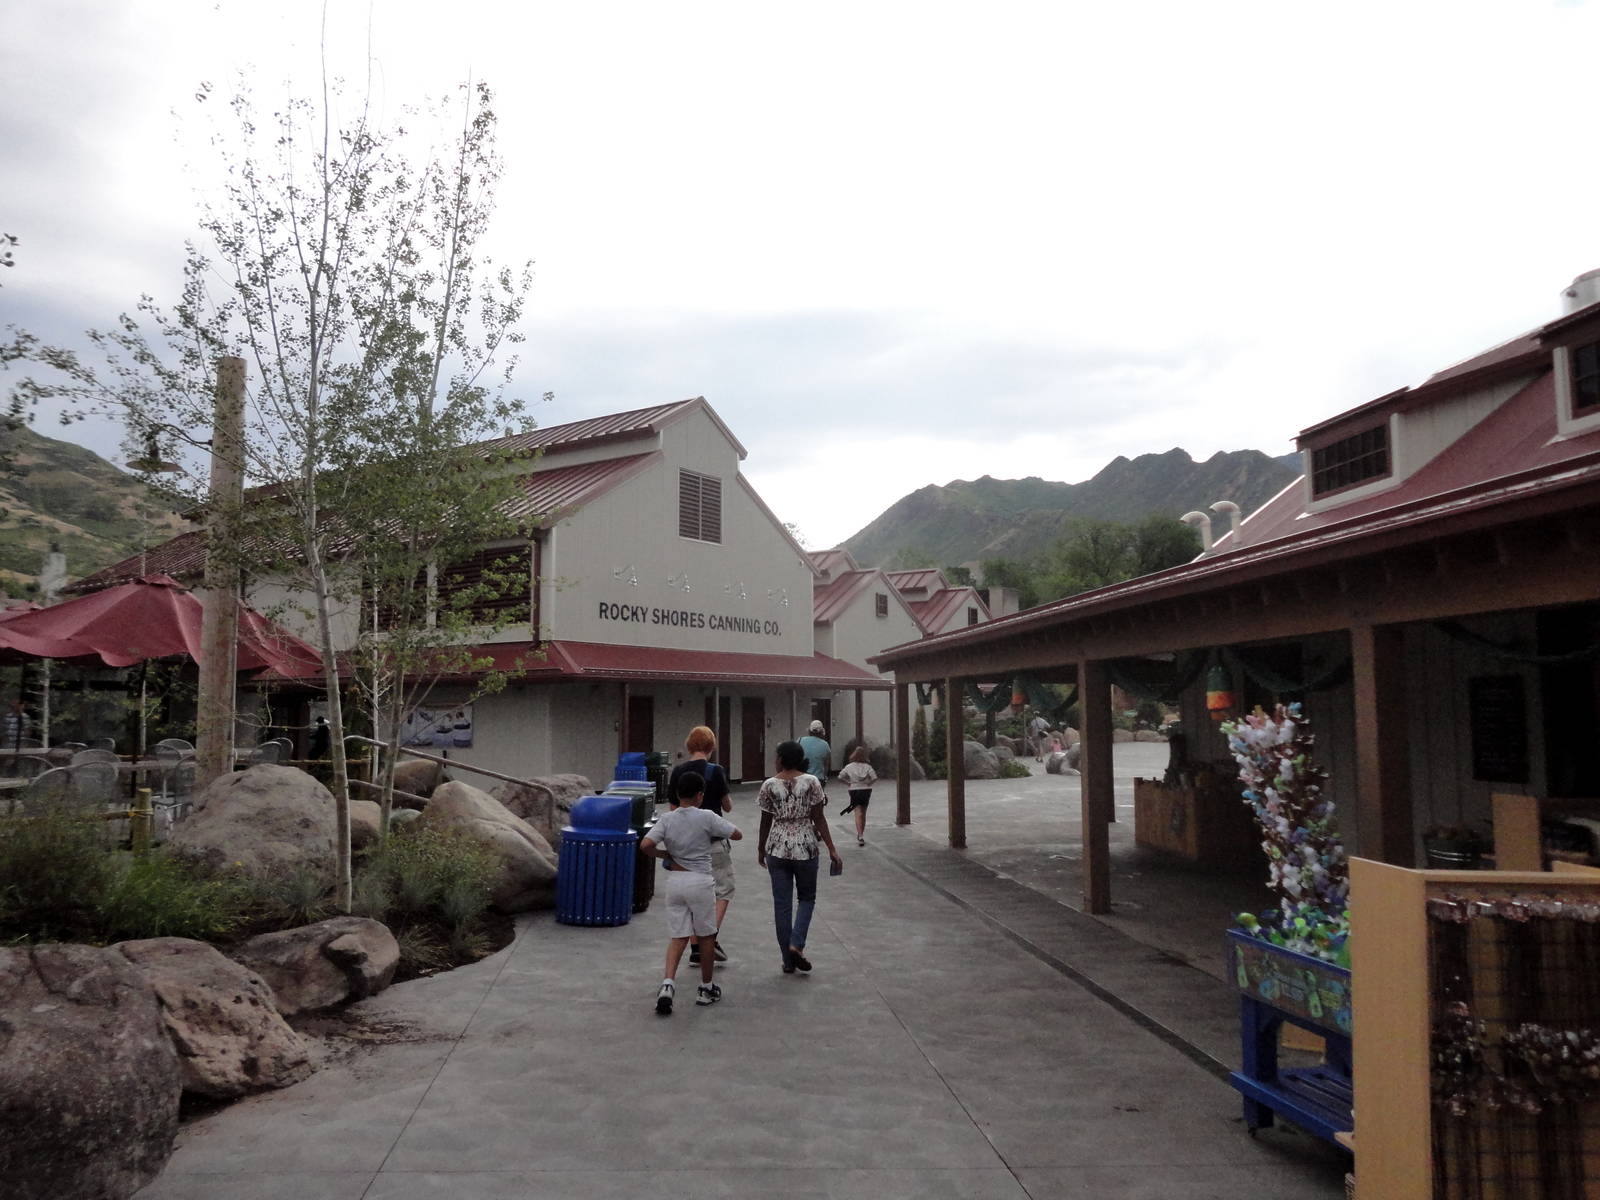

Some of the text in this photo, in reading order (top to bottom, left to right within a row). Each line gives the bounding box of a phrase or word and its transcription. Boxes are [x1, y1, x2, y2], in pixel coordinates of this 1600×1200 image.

[599, 602, 782, 636] ROCKY SHORES CANNING CO.
